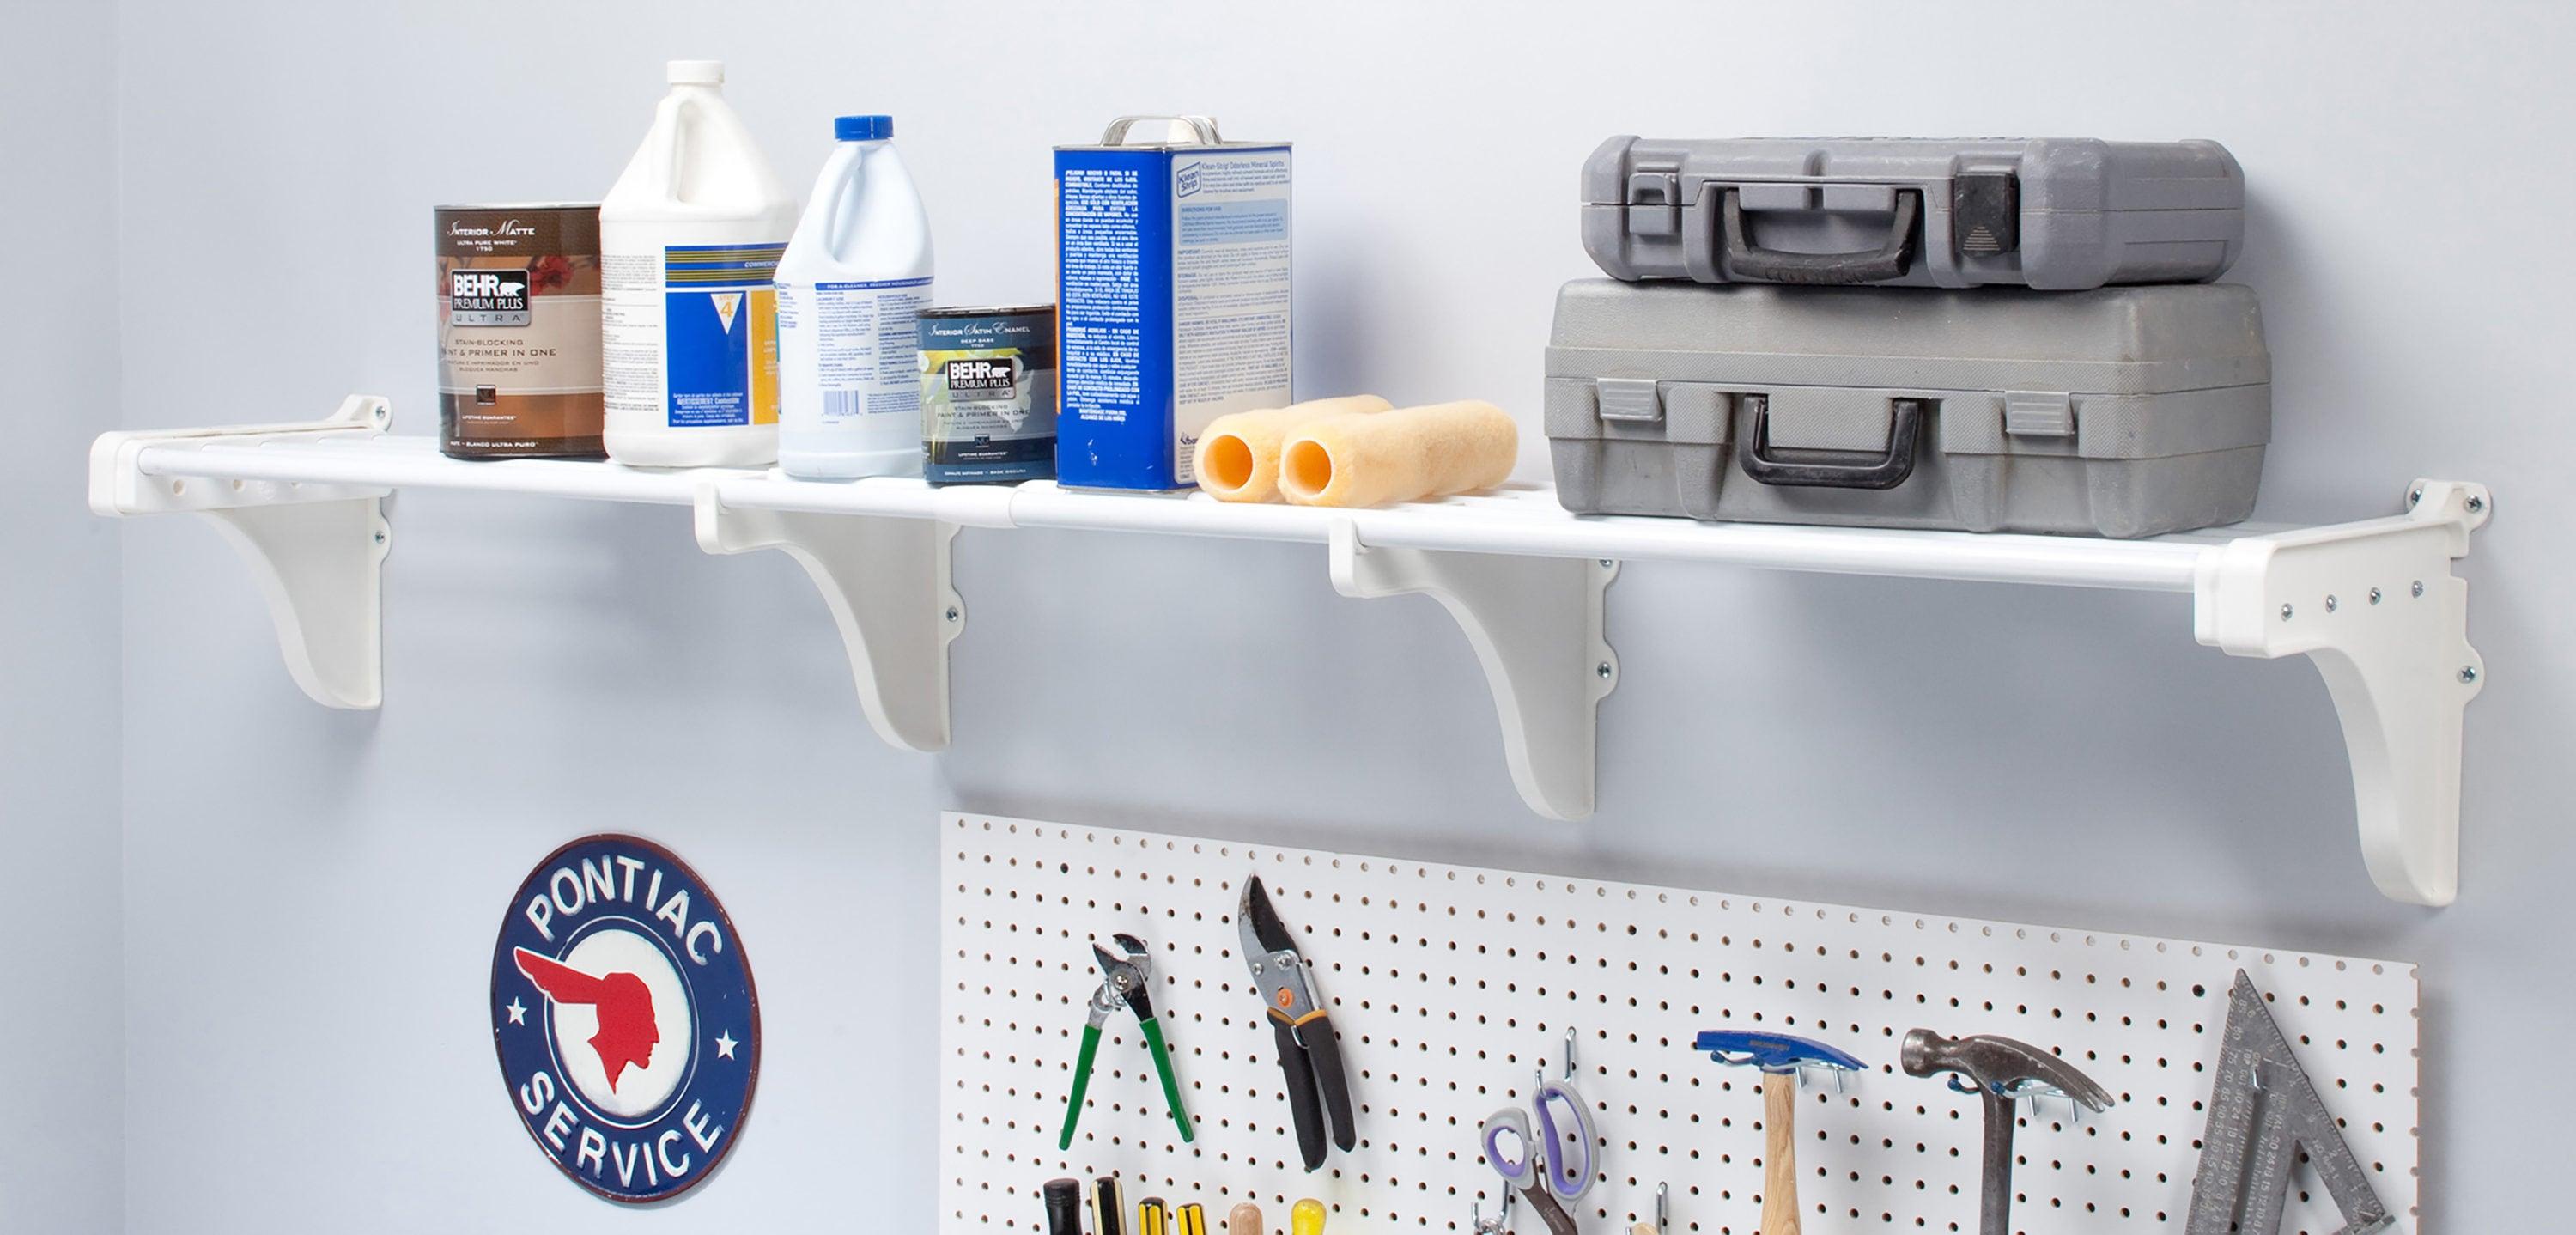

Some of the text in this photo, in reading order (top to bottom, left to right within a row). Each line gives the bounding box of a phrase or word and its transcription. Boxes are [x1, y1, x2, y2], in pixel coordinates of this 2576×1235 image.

[1178, 170, 1199, 183] Klean
[1181, 180, 1197, 192] Strip
[492, 219, 536, 236] MATTE
[453, 274, 499, 297] BEHR
[453, 298, 523, 310] PREMIUM PLUS
[720, 301, 733, 318] 4
[456, 314, 522, 322] ULTRA
[928, 321, 1030, 336] INTERIOR SATIN ENAMEL
[469, 348, 507, 357] PRIMER
[513, 348, 525, 356] IN
[530, 348, 556, 356] ONE
[950, 362, 991, 380] BEHR
[951, 378, 1010, 389] PREMIUM PLUS
[953, 390, 1009, 398] ULTRA
[526, 855, 723, 966] PONTIAC
[519, 1070, 724, 1189] SERVICE
